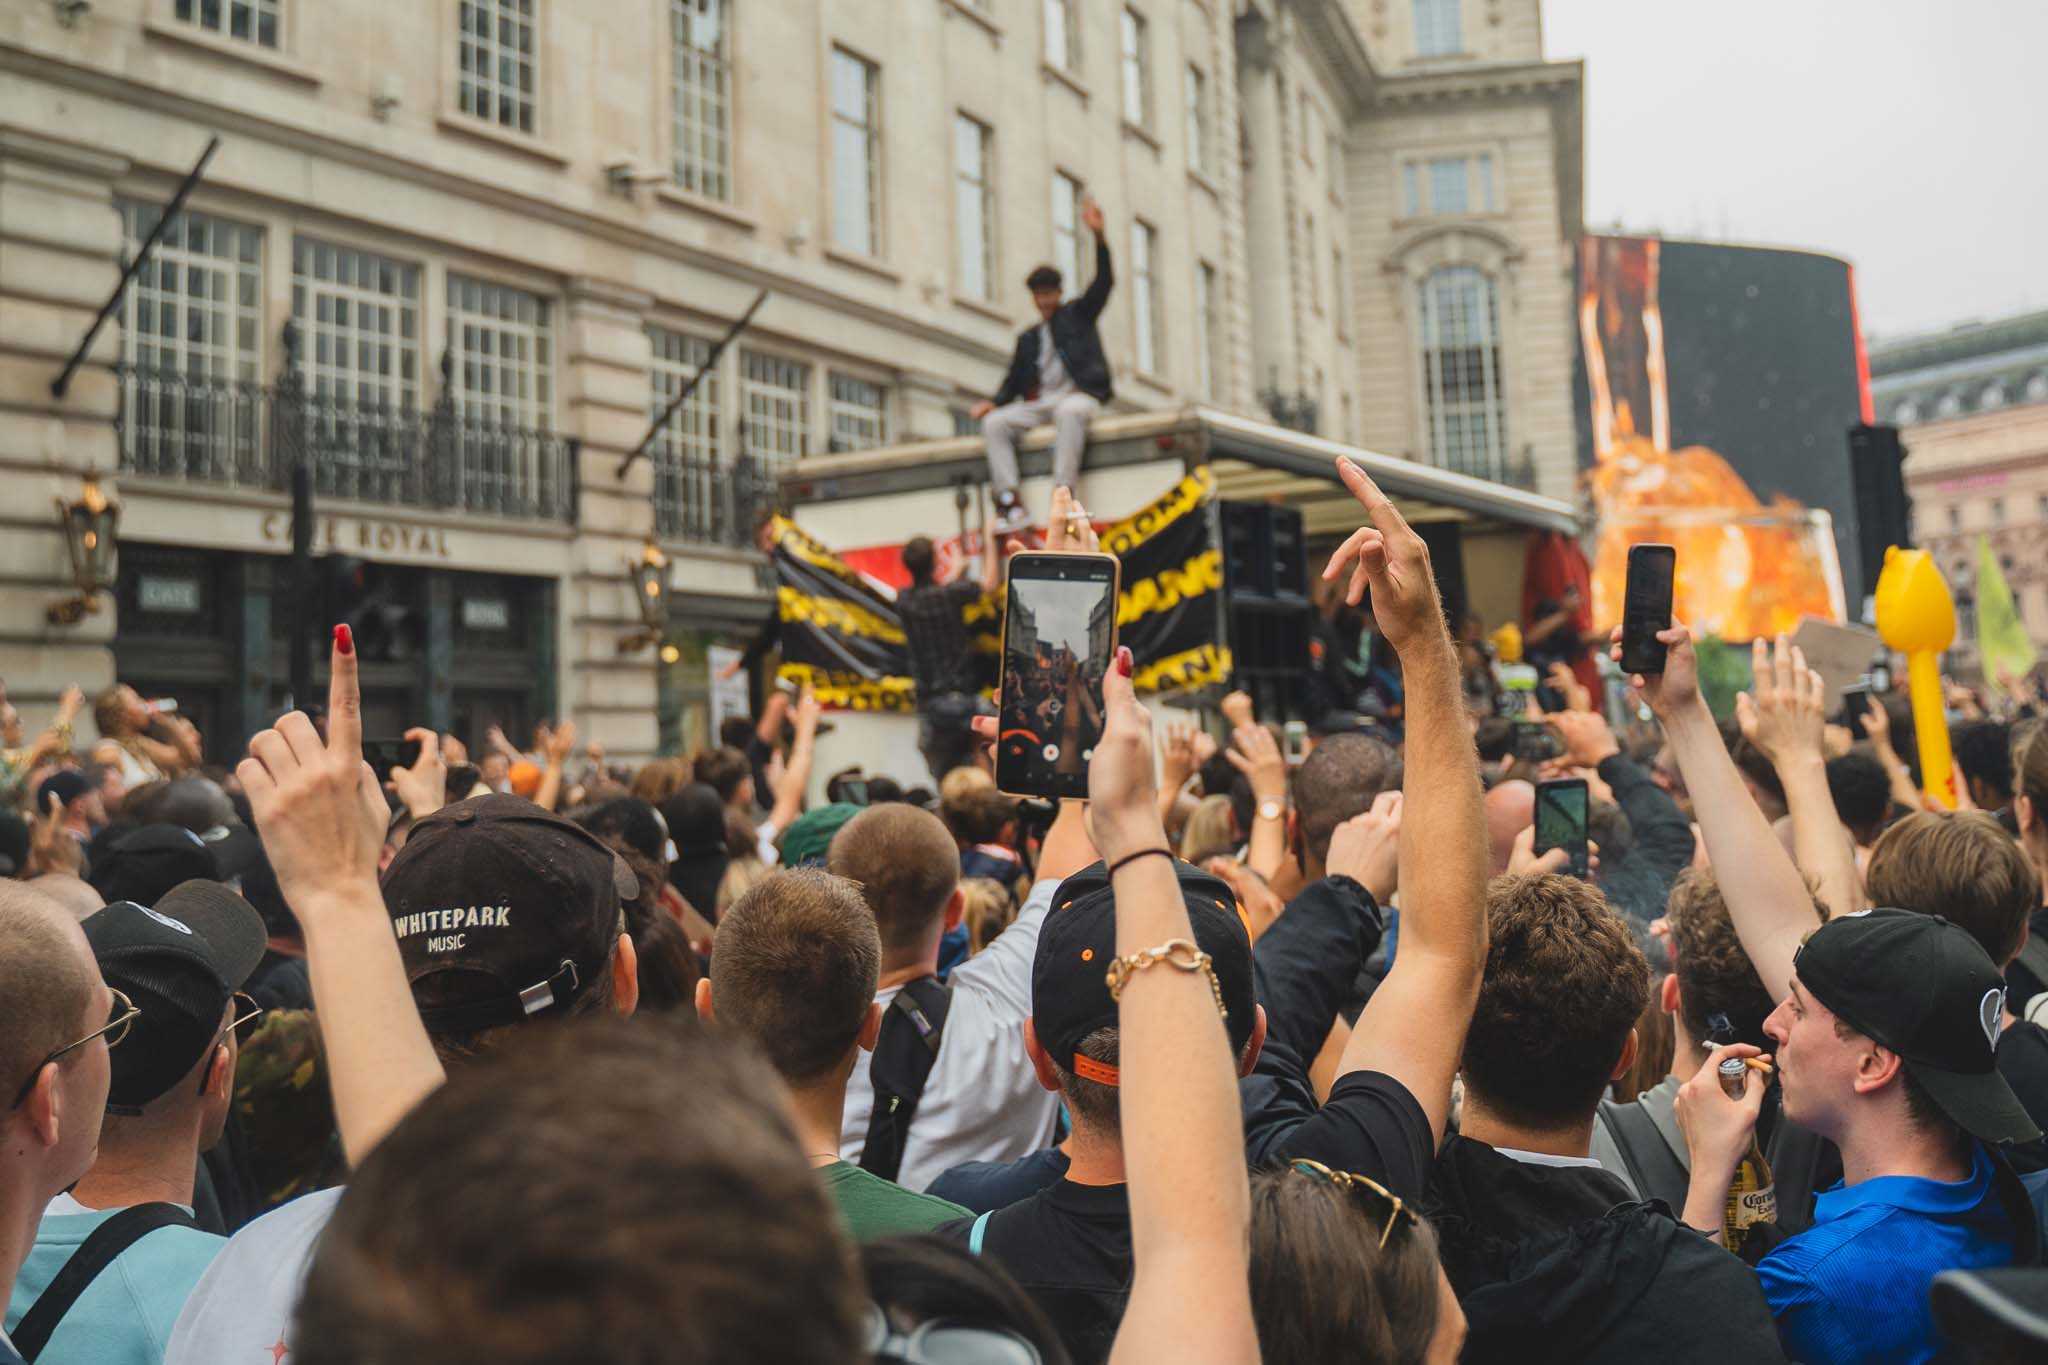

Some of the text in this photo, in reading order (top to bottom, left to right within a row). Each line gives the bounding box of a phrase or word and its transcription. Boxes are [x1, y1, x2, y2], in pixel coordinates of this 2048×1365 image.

[358, 520, 449, 557] ROYAL
[394, 905, 512, 939] WHITEPARK
[427, 933, 467, 953] MUSIC
